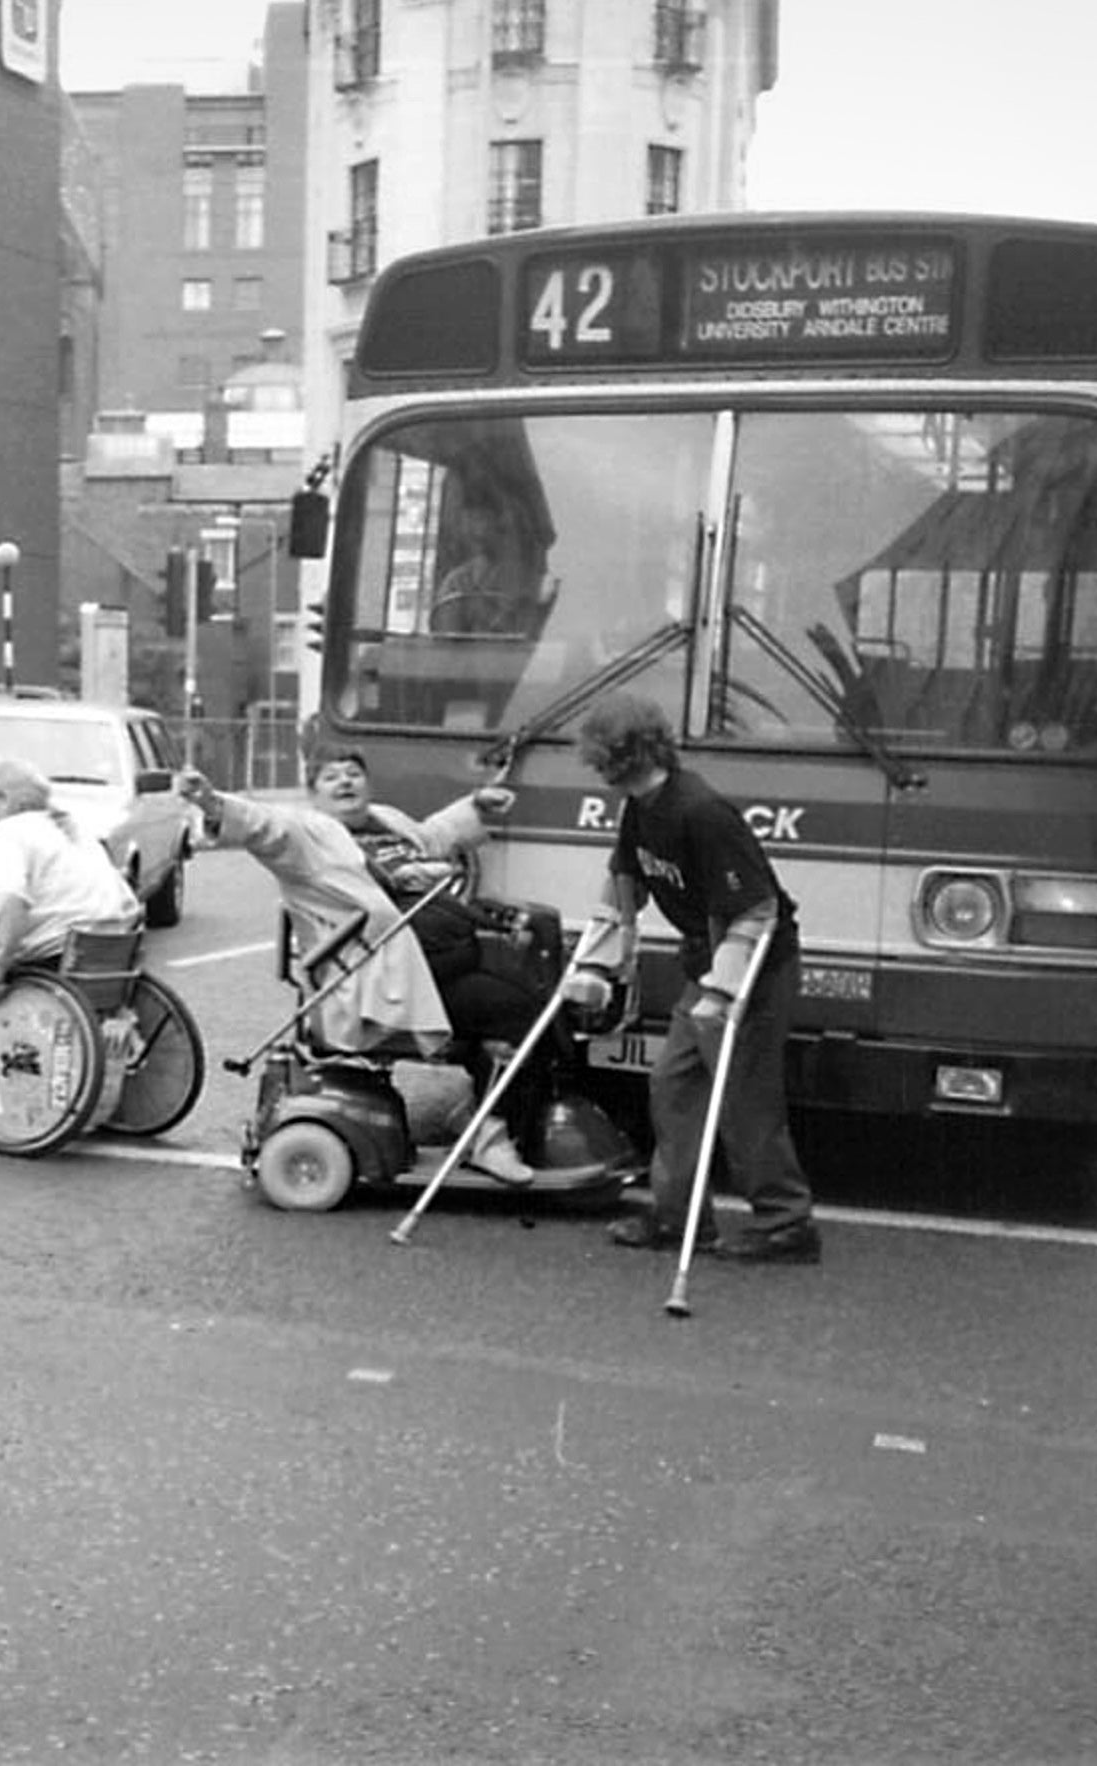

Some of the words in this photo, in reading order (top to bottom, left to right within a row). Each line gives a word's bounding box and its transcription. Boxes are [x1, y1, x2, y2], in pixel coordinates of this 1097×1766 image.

[700, 251, 854, 292] STOCKPORT
[865, 252, 907, 283] BUS
[530, 266, 613, 350] 42
[818, 295, 925, 316] WITHINGTON
[697, 320, 791, 341] UNIVERSITY
[802, 317, 879, 338] ARNDALE
[883, 314, 950, 336] CENTRE
